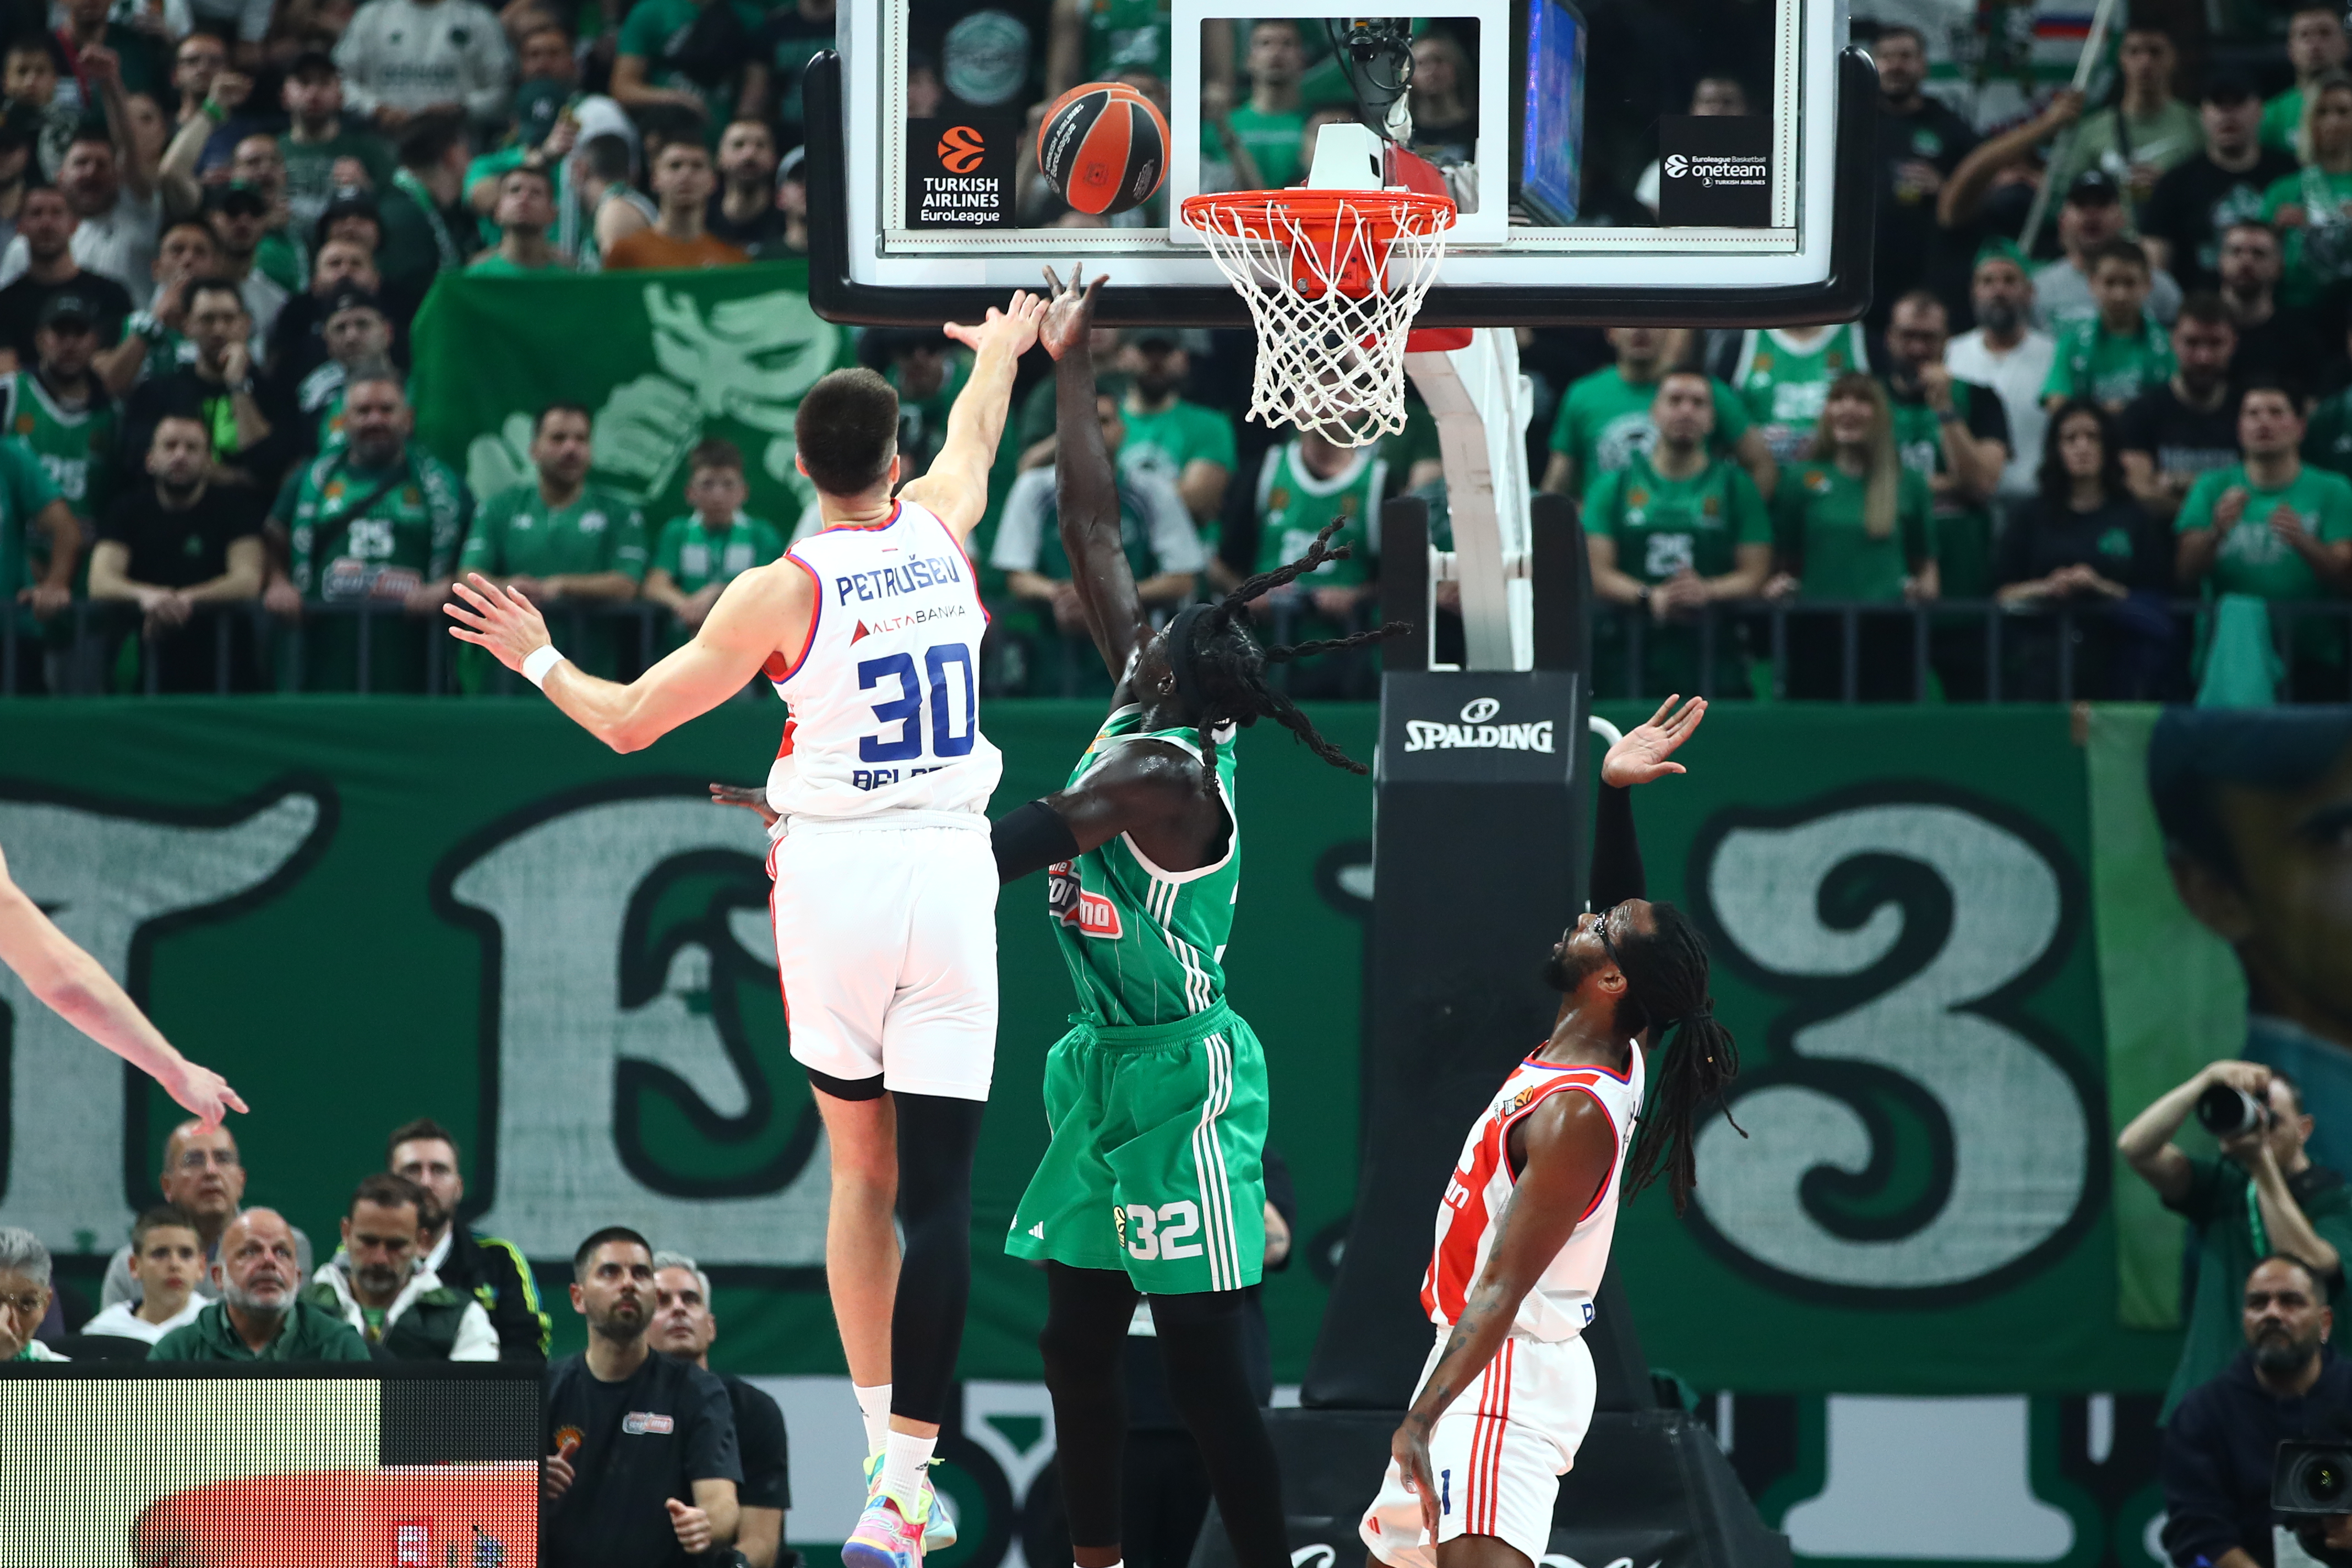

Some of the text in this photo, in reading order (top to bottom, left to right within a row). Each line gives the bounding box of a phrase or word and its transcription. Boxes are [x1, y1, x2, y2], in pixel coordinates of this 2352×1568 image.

[1692, 156, 1731, 164] Euroleague
[1692, 164, 1766, 177] oneteam
[923, 178, 999, 192] TURKISH
[922, 193, 999, 208] AIRLINES
[921, 209, 1000, 225] EuroLeague
[835, 554, 961, 606] PETRUŠEV
[858, 643, 976, 763] 30
[1404, 720, 1554, 754] SPALDING
[1126, 1200, 1204, 1260] 32
